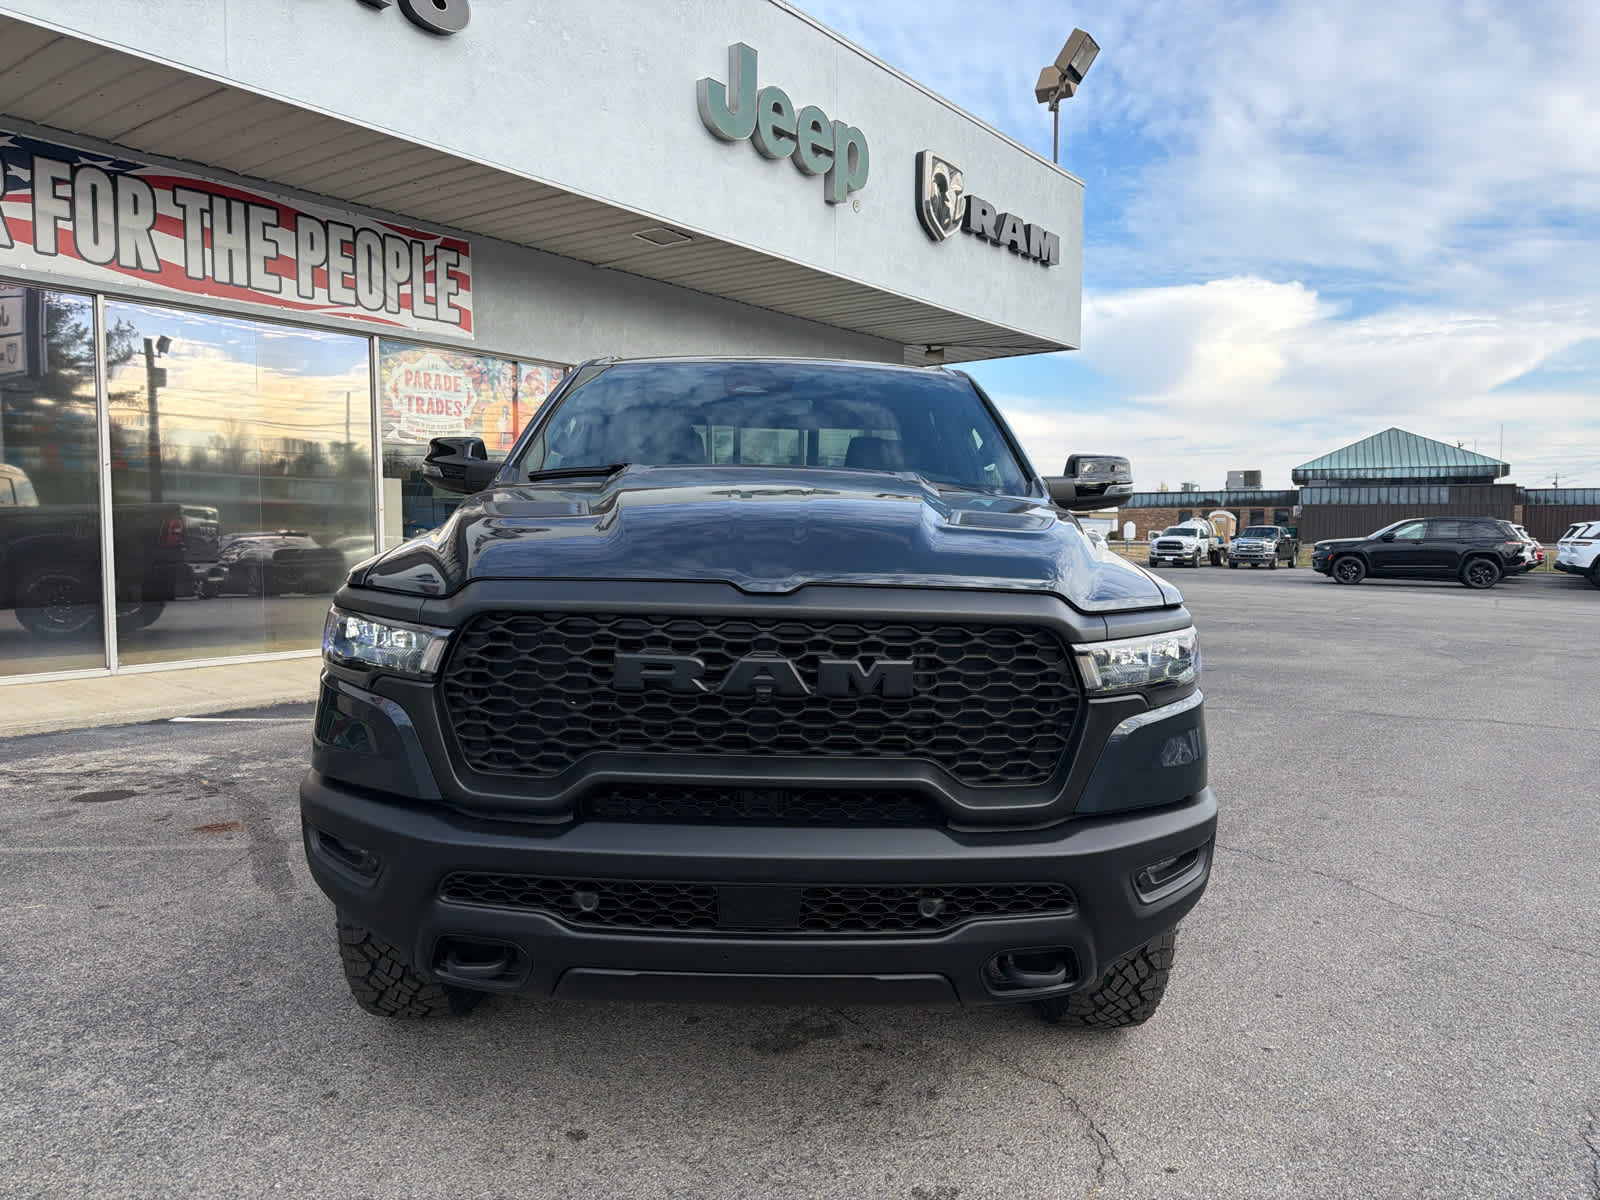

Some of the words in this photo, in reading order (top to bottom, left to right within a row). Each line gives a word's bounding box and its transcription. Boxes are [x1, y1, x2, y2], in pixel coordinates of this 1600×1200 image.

[696, 41, 869, 204] Jeep
[31, 154, 161, 273] FOR
[172, 184, 282, 294] THE
[295, 212, 463, 325] PEOPLE
[962, 194, 1060, 266] RAM
[404, 368, 462, 393] PARADE
[405, 394, 463, 417] TRADES
[613, 650, 914, 698] RAM
